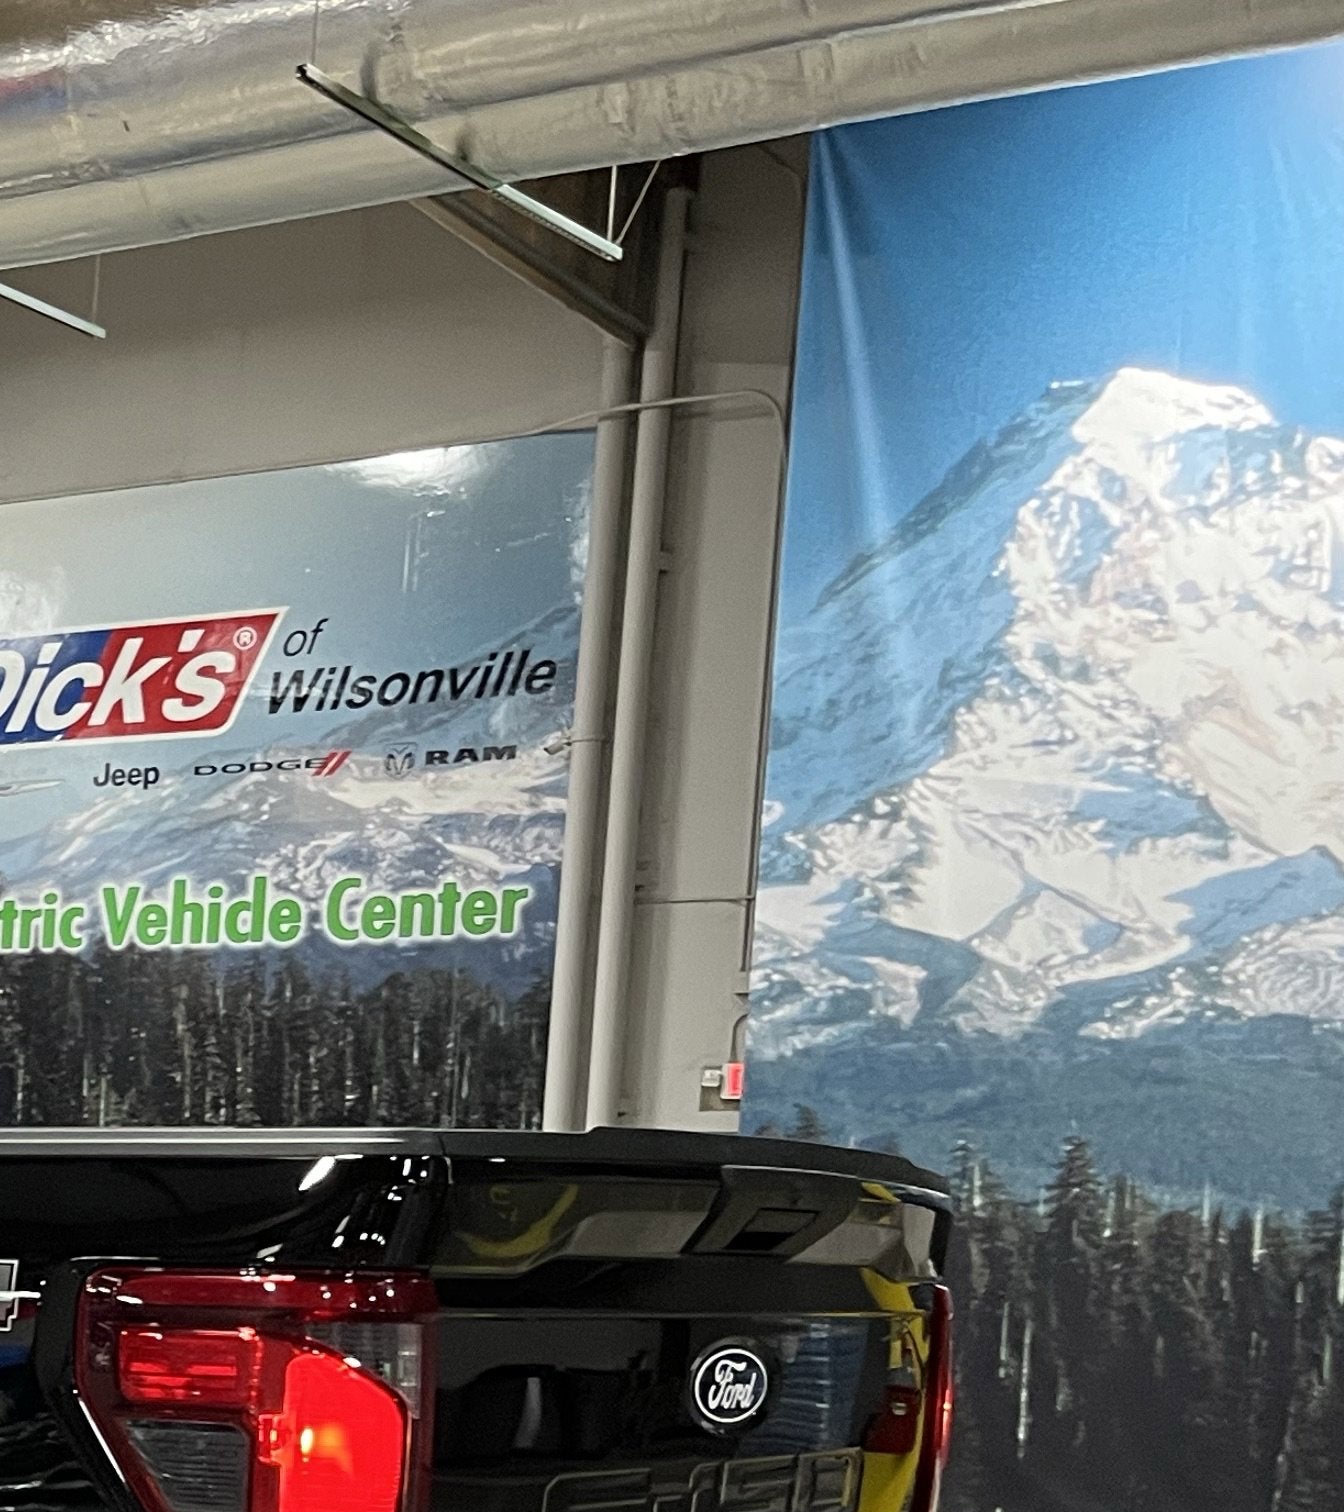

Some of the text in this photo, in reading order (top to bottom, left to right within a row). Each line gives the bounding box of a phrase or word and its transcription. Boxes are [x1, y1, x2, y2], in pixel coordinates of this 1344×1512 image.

[282, 617, 329, 657] of
[268, 648, 557, 715] Wilsonville
[93, 744, 518, 790] Jeep DODGE RAM
[102, 875, 303, 947] Vehicle
[324, 876, 530, 941] Center
[707, 1358, 757, 1411] Ford
